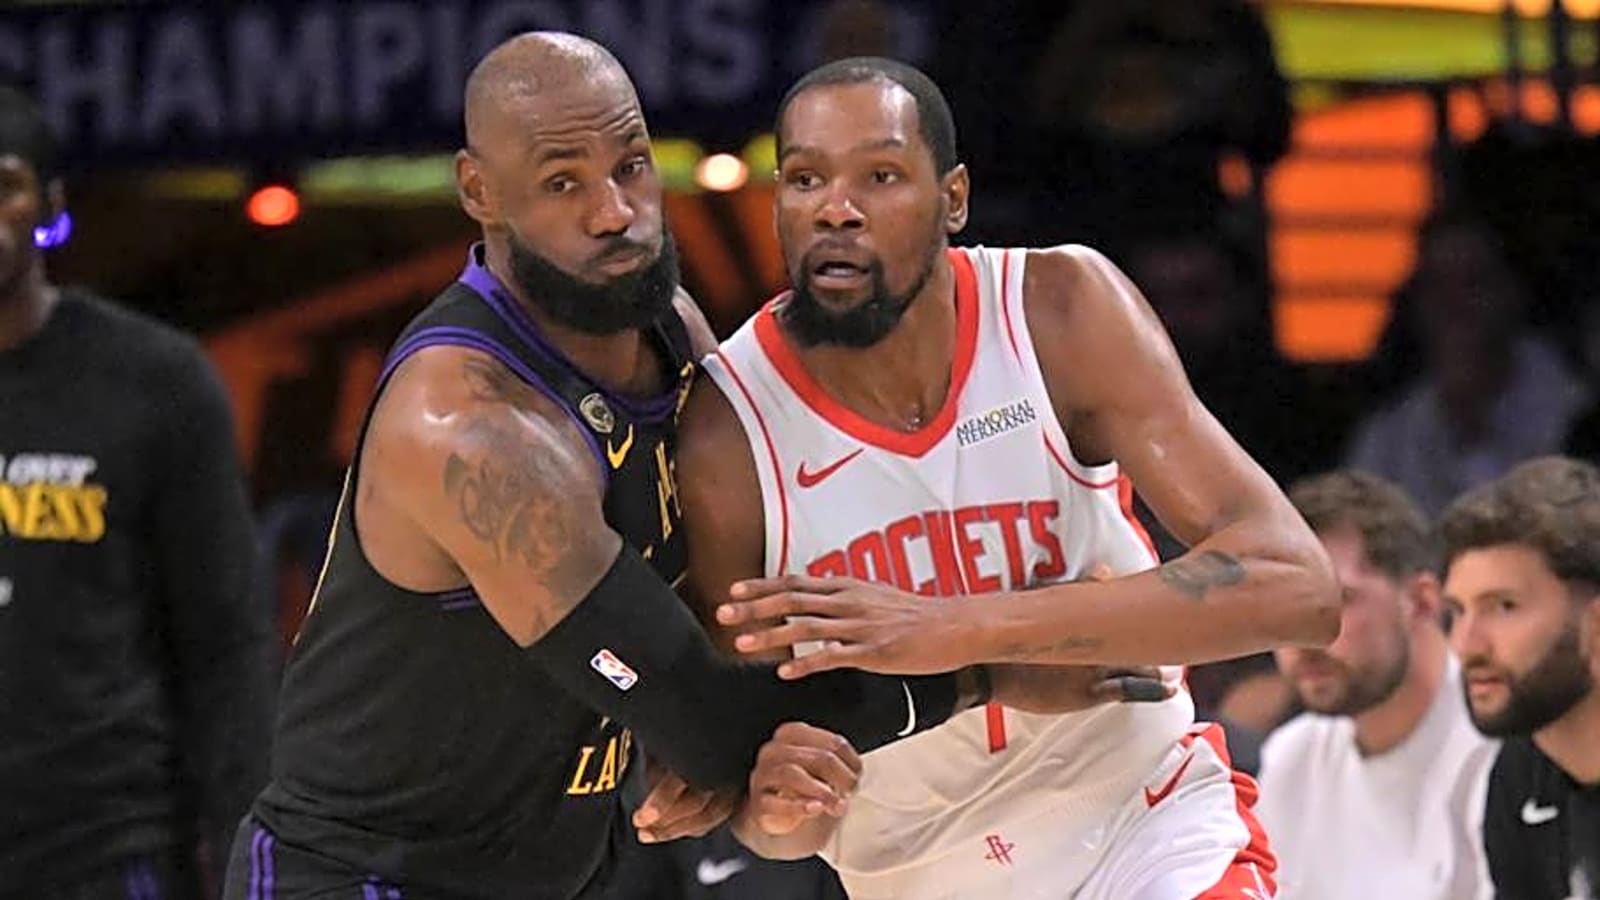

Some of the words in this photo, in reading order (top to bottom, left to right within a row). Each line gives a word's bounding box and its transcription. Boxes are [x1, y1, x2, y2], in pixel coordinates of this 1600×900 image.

[0, 0, 765, 141] HAMPINS
[957, 399, 1034, 435] MEMORIAL
[957, 407, 1036, 447] HERMANN
